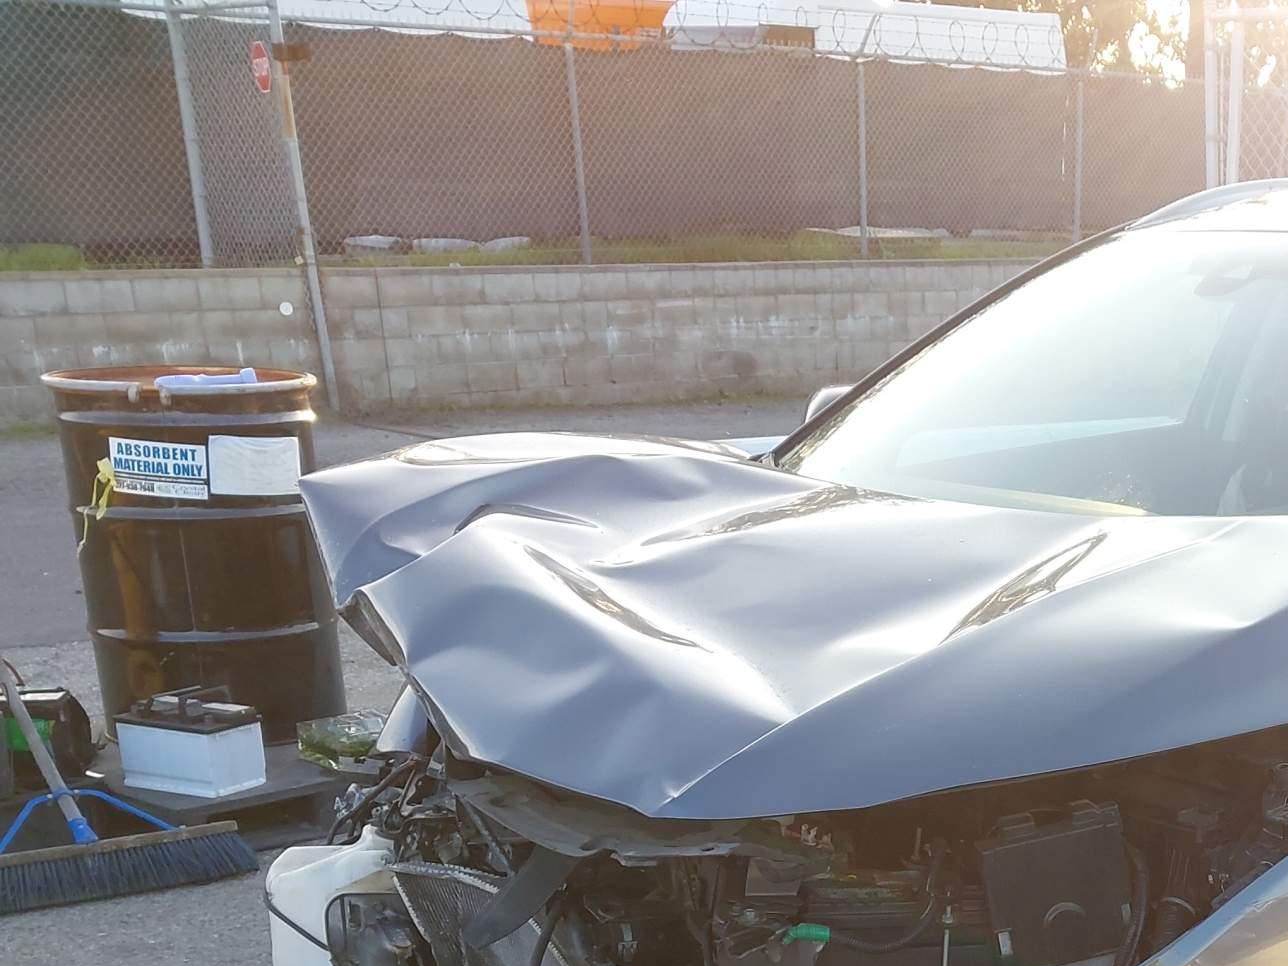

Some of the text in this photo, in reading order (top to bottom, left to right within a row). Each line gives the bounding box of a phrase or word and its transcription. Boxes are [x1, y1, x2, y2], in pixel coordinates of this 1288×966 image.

[117, 442, 197, 461] ABSORBENT
[113, 457, 203, 477] MATERIAL ONLY
